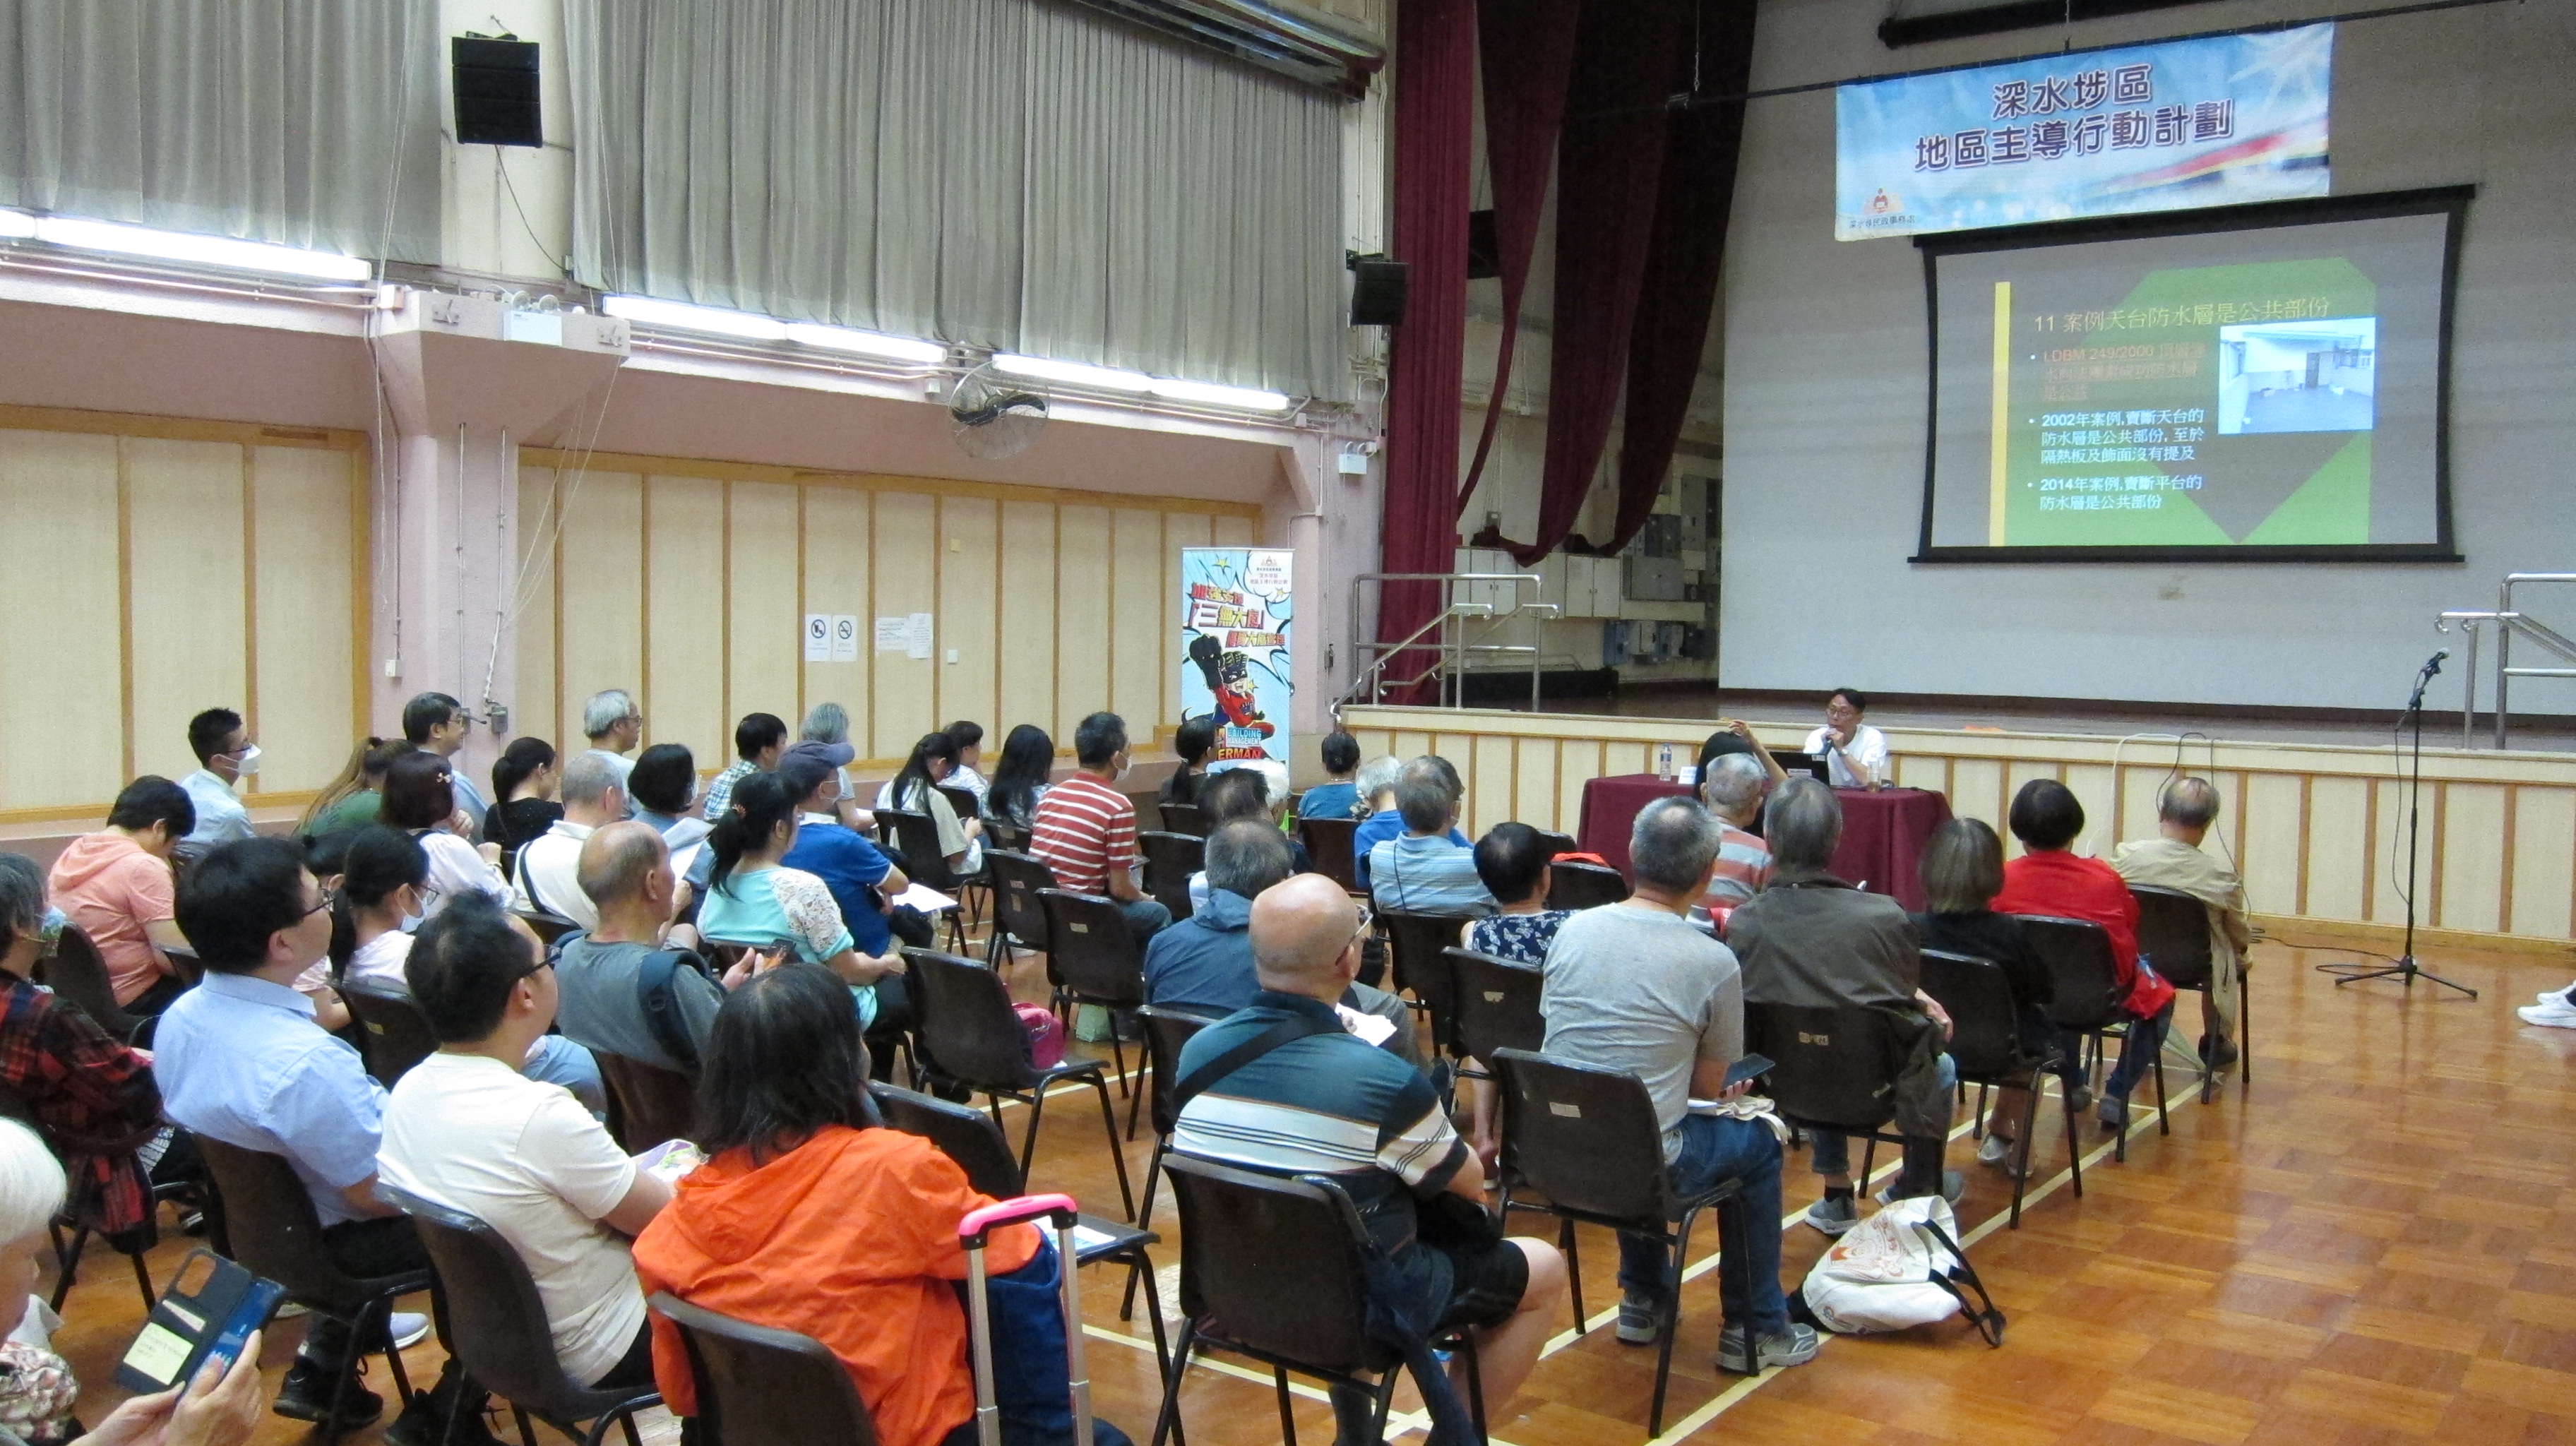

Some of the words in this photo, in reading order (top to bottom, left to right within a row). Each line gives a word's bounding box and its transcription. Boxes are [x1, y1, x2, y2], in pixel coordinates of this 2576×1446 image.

[1991, 62, 2152, 121] 深水埗區
[1914, 99, 2234, 172] 地區主導行動計劃
[2034, 315, 2054, 333] 11
[2063, 296, 2330, 333] 案例天台防水層是公共部份
[2043, 348, 2085, 363] LDBM
[2173, 426, 2205, 443] 至於
[2039, 494, 2162, 511] 防水層是公共部份
[1227, 736, 1262, 745] MANAGEMENT
[1228, 727, 1262, 738] BUILDING
